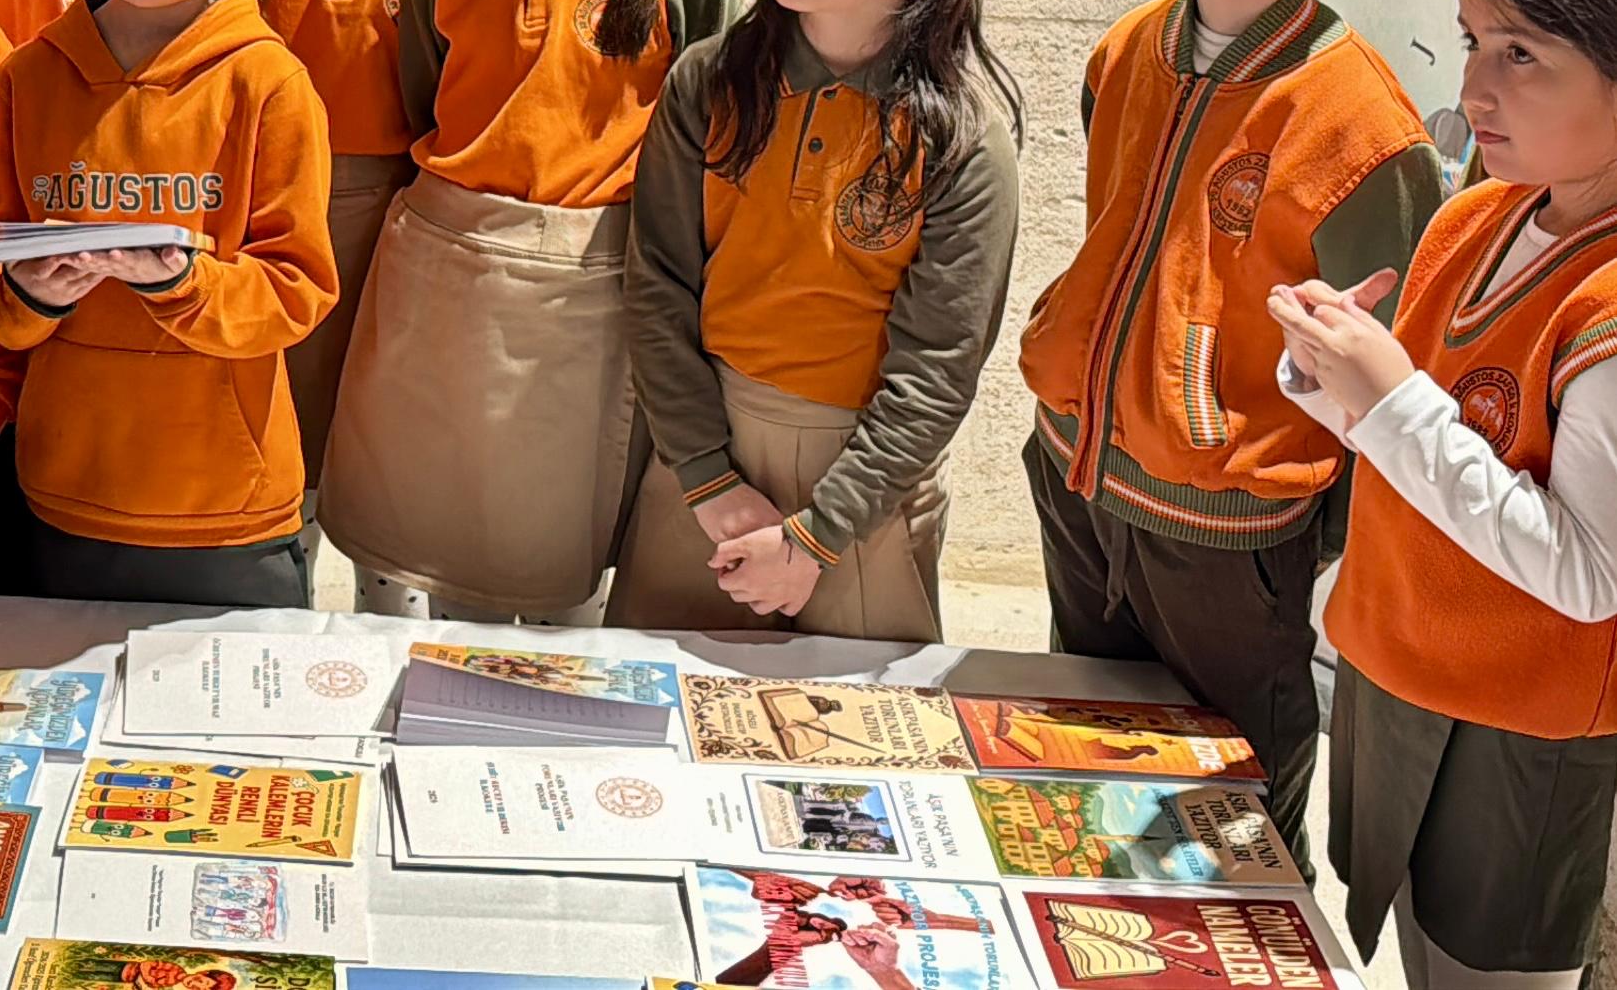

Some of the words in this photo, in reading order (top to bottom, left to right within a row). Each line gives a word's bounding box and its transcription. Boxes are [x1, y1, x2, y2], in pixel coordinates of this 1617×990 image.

[44, 160, 224, 214] AĞUSTOS
[858, 705, 884, 744] YAZIYOR
[876, 699, 909, 752] TORUNLARI
[207, 780, 239, 826] DÜNYASI
[235, 785, 262, 824] RENKLİ
[290, 791, 317, 828] ÇOCUK
[1184, 804, 1224, 851] YAZIYOR
[1205, 799, 1254, 863] TORUNLARI
[915, 934, 941, 990] PROJES
[1196, 904, 1273, 987] NAMELER
[1245, 905, 1325, 989] GÖNÜLDEN
